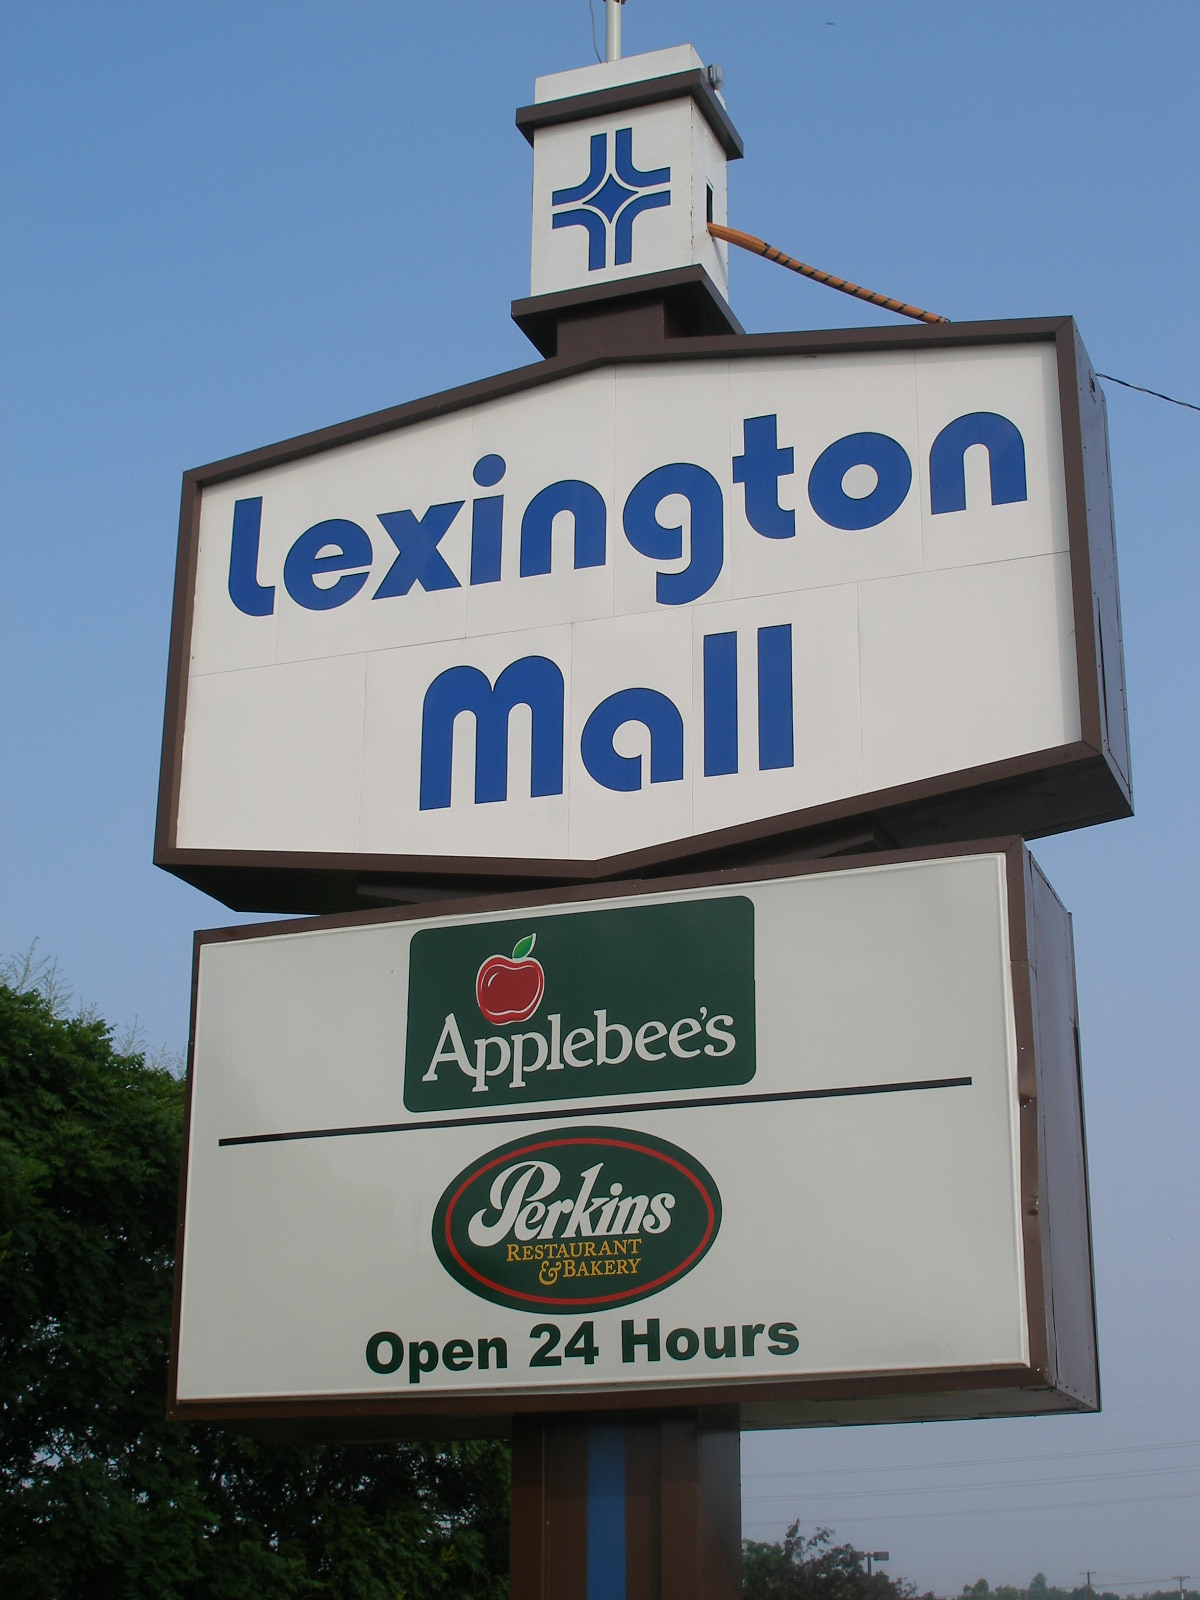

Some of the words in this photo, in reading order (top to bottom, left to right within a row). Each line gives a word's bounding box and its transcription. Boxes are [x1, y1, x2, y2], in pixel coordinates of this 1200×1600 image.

[421, 1006, 737, 1093] Applebee's
[467, 1160, 676, 1248] Perkins
[506, 1238, 642, 1263] RESTAURANT
[366, 1331, 507, 1384] Open
[528, 1321, 600, 1368] 24
[621, 1317, 799, 1364] Hours
